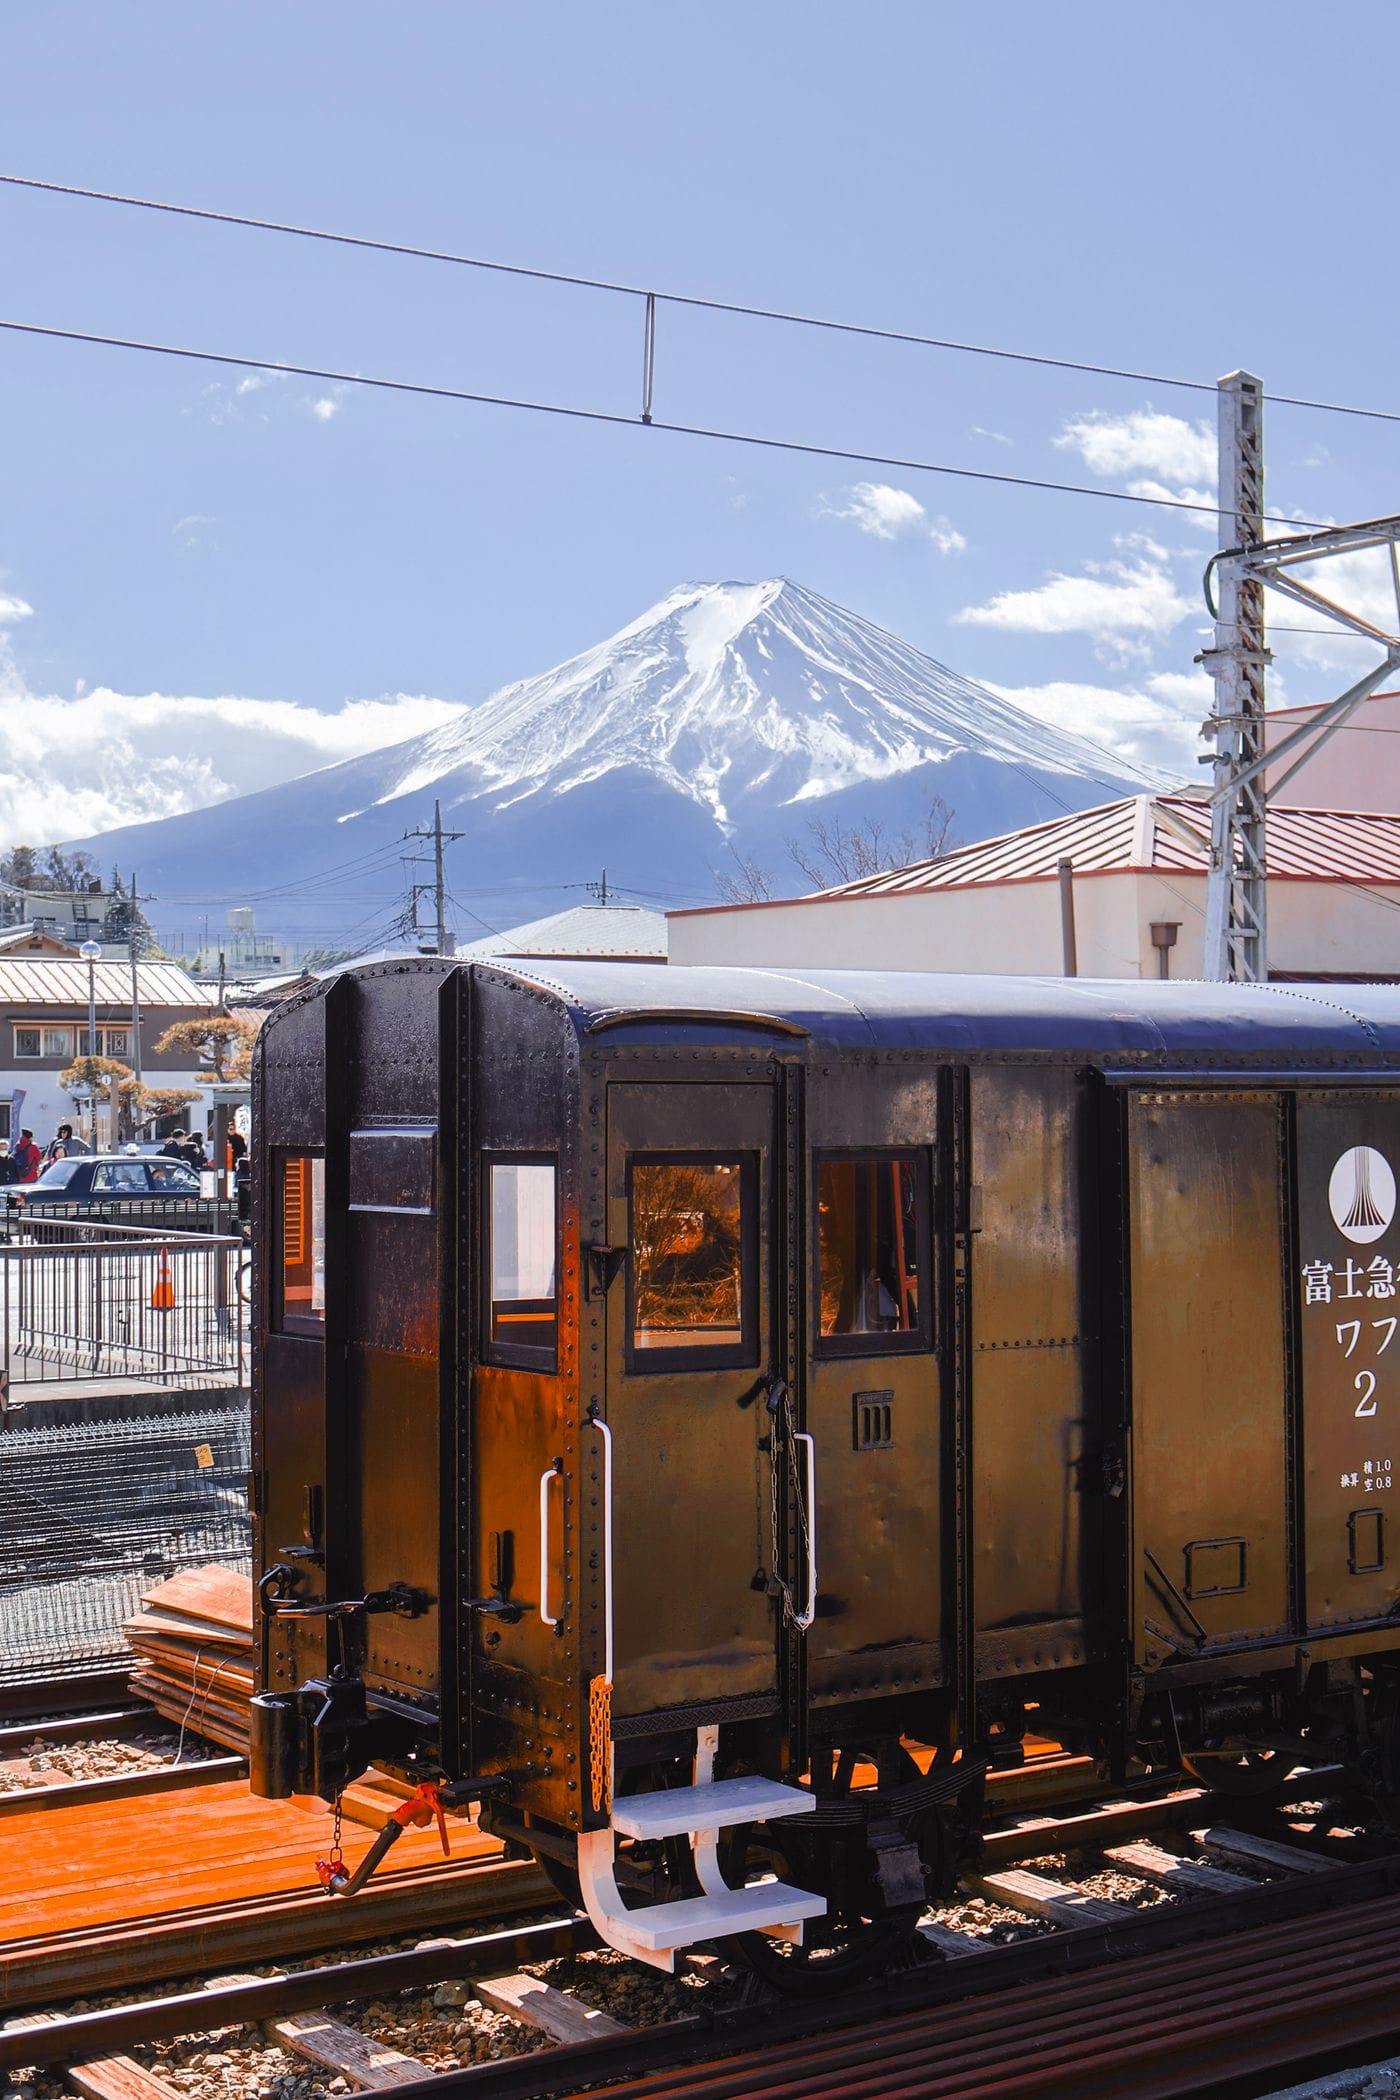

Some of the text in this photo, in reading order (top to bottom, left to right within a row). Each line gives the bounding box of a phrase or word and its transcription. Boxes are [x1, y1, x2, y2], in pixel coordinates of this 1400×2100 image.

[1301, 1255, 1400, 1305] 富士急
[1335, 1317, 1398, 1358] ワフ
[1354, 1370, 1377, 1417] 2
[1376, 1459, 1391, 1472] 1.0
[1376, 1476, 1392, 1489] 0.8
